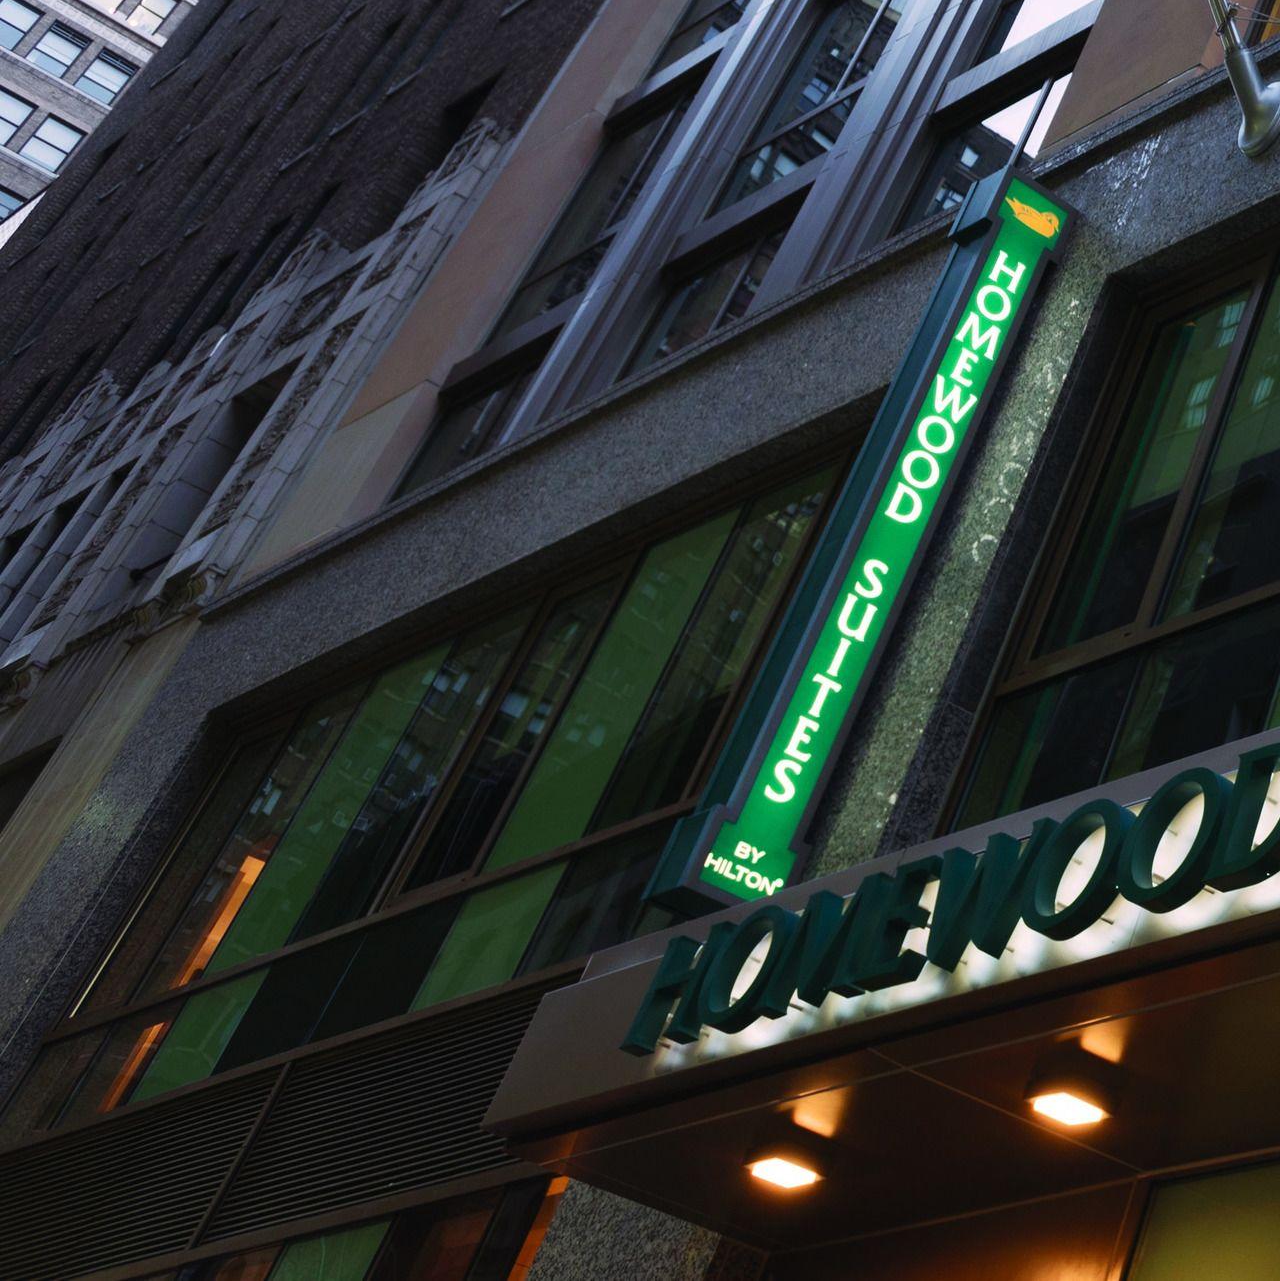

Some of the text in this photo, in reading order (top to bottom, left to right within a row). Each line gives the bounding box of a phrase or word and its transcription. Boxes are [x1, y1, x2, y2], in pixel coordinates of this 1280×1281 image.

[764, 250, 1026, 805] HOMEWOOD SUITES
[733, 840, 767, 865] BY
